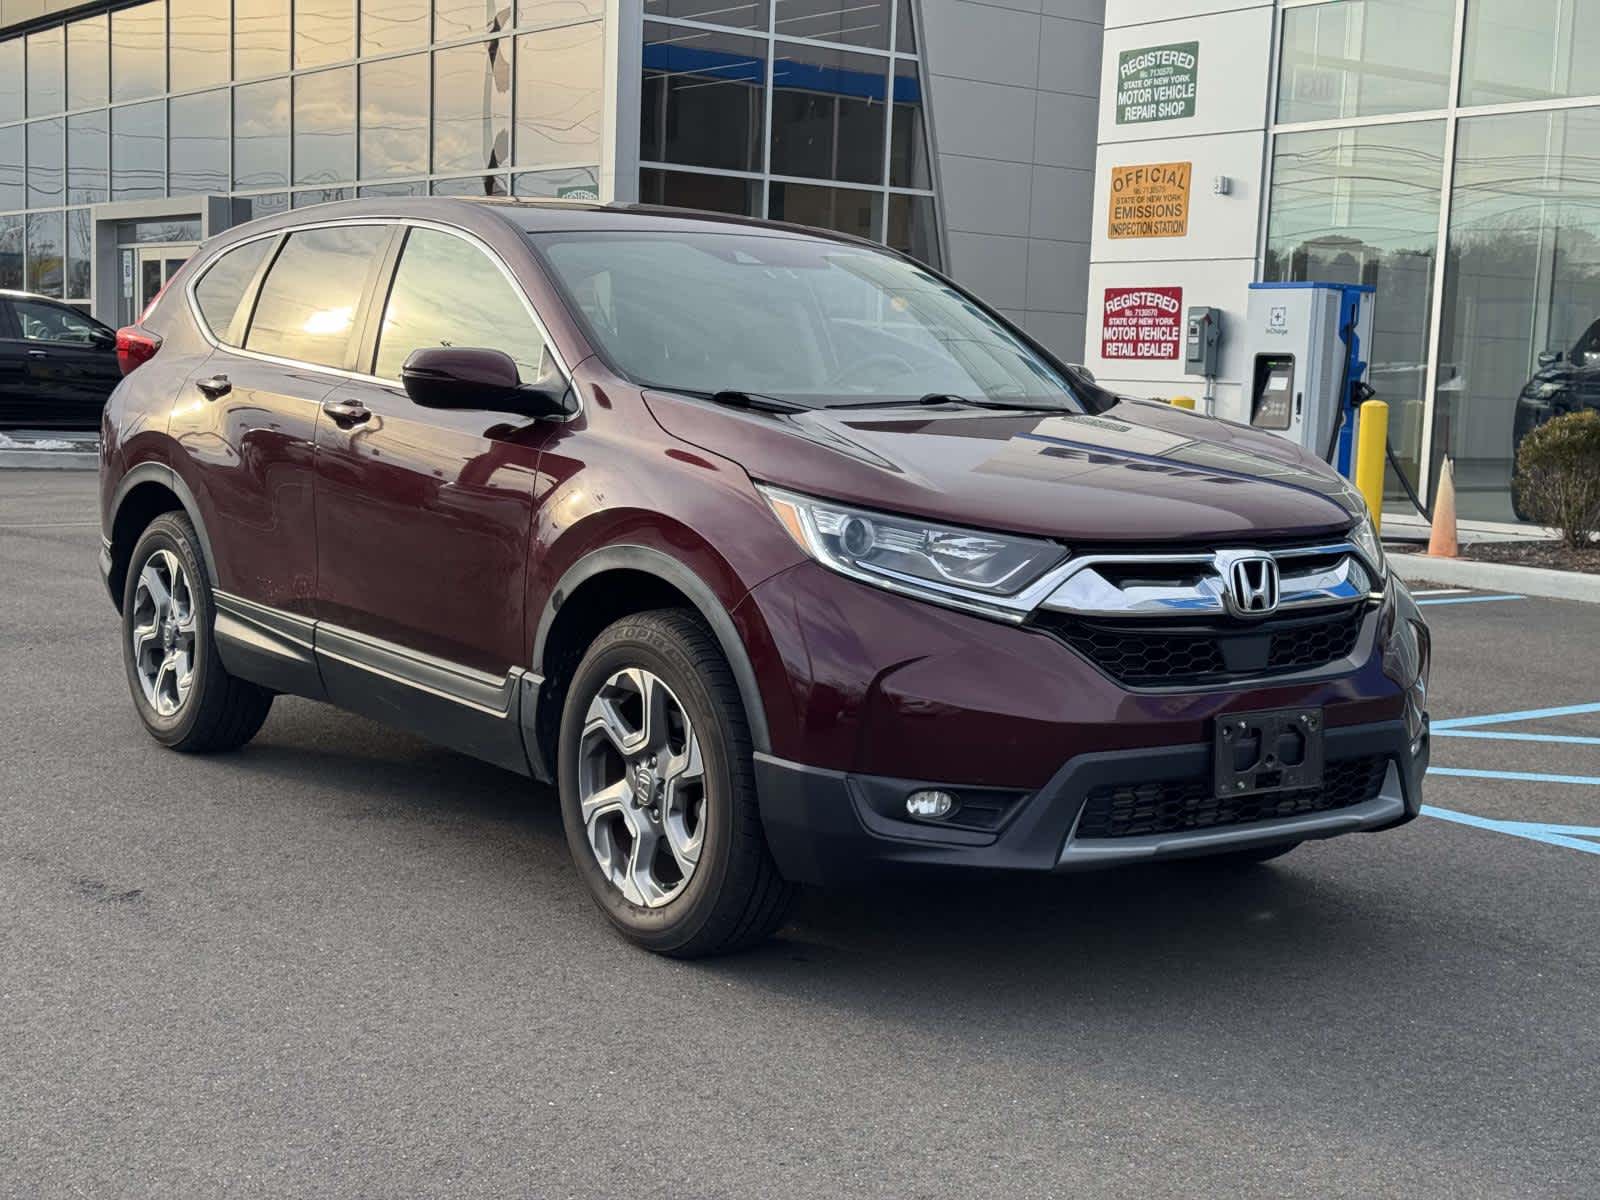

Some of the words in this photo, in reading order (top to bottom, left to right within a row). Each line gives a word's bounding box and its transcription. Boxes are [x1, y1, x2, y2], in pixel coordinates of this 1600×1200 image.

[1121, 51, 1195, 79] REGISTERED
[1123, 80, 1142, 90] STATE
[1144, 79, 1153, 87] OF
[1153, 77, 1169, 85] NEW
[1170, 75, 1190, 84] YORK
[1118, 89, 1151, 105] MOTOR
[1153, 83, 1195, 101] VEHICLE
[1125, 104, 1156, 121] REPAIR
[1158, 101, 1185, 117] SHOP
[1113, 167, 1185, 192] OFFICIAL
[1116, 196, 1135, 205] STATE
[1136, 195, 1145, 203] OF
[1146, 195, 1162, 203] NEW
[1163, 193, 1181, 202] YORK
[1114, 203, 1183, 220] EMISSIONS
[1110, 221, 1152, 236] INSPECTION
[1153, 221, 1184, 234] STATION
[1105, 292, 1179, 314] REGISTERED
[1104, 327, 1136, 340] MOTOR
[1138, 327, 1179, 340] VEHICLE
[1106, 343, 1136, 357] RETAIL
[1137, 343, 1174, 357] DEALER
